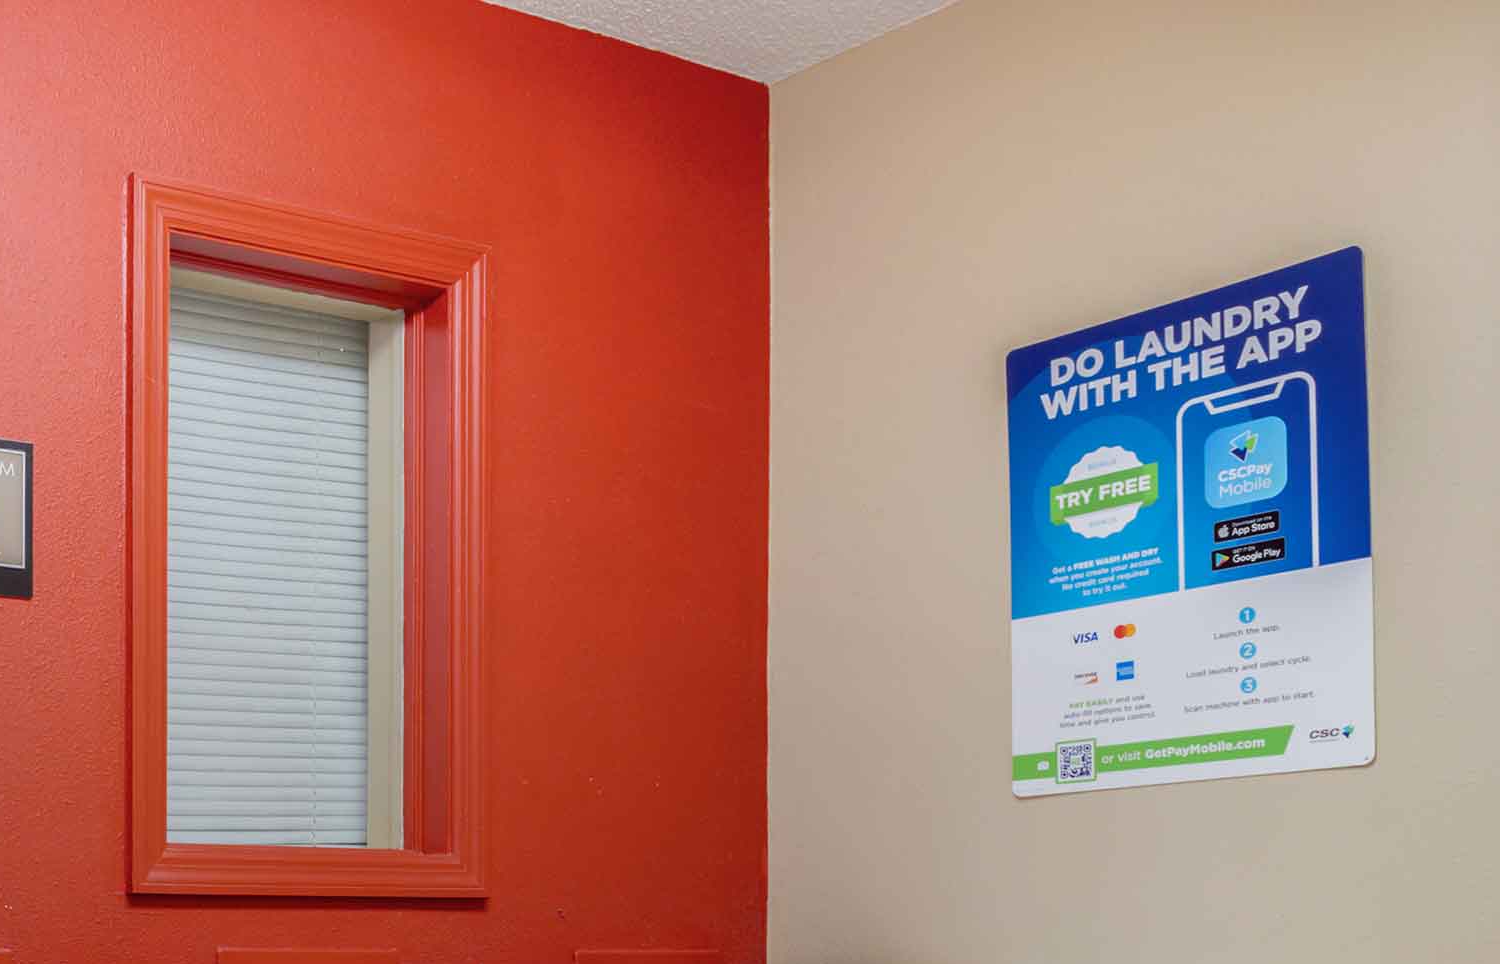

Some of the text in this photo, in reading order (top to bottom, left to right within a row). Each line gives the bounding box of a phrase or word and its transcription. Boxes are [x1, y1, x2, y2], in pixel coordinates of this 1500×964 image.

[1050, 285, 1309, 388] DO LAUNDRY
[1040, 320, 1322, 420] WITH THE APP
[1217, 464, 1273, 482] CSCPay
[1055, 474, 1152, 509] TRY FREE
[1219, 478, 1273, 497] Mobile
[1231, 521, 1276, 536] App Store
[1122, 551, 1141, 561] AND
[1141, 546, 1160, 558] DRY
[1232, 548, 1282, 563] Google Play
[1244, 609, 1251, 621] 1
[1072, 631, 1099, 644] VISA
[1212, 629, 1244, 640] Launch
[1245, 627, 1260, 635] the
[1243, 644, 1254, 656] 2
[1243, 678, 1254, 692] 3
[1309, 727, 1341, 740] CSC
[1100, 738, 1267, 764] or visit GetPayMobile.com
